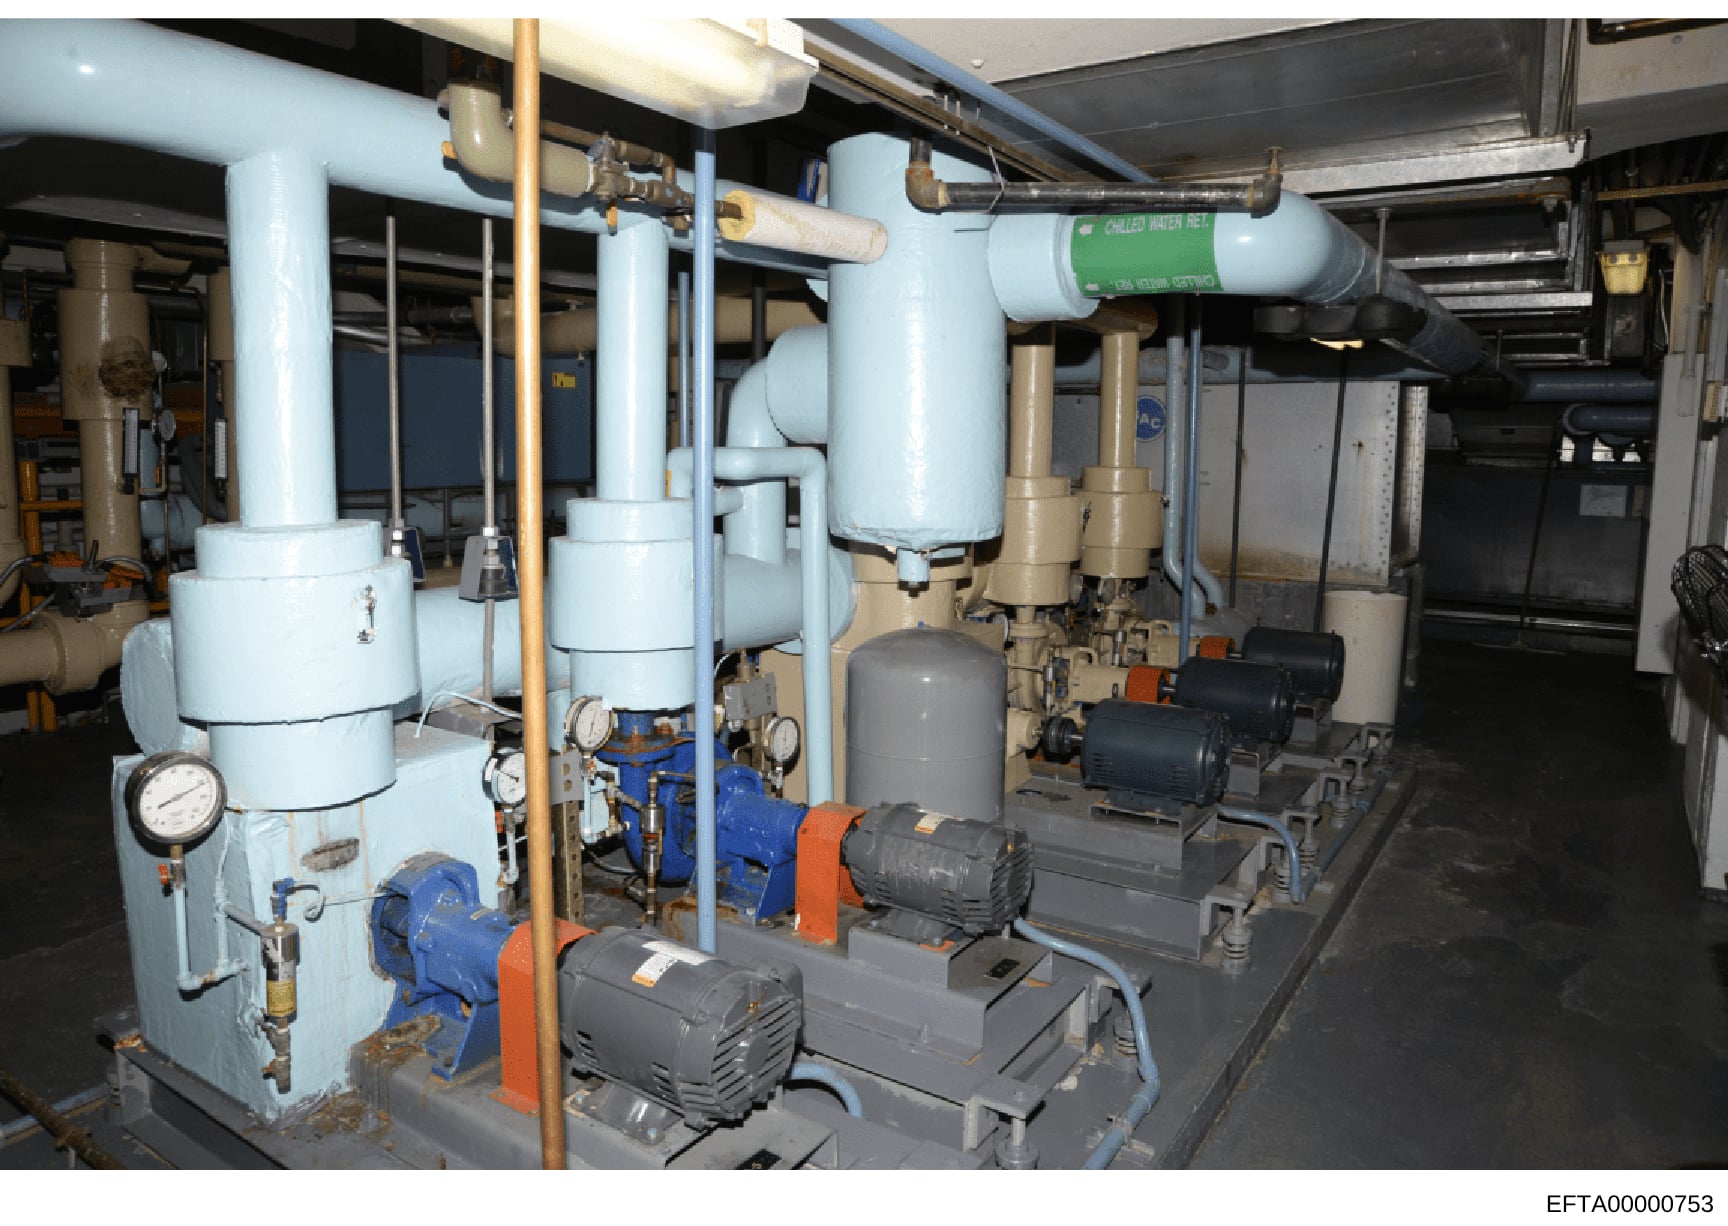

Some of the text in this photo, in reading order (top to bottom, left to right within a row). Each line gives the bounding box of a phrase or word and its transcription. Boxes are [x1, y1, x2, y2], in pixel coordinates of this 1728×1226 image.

[1105, 212, 1209, 235] CHILLED WATER RET.
[1137, 413, 1161, 429] AC
